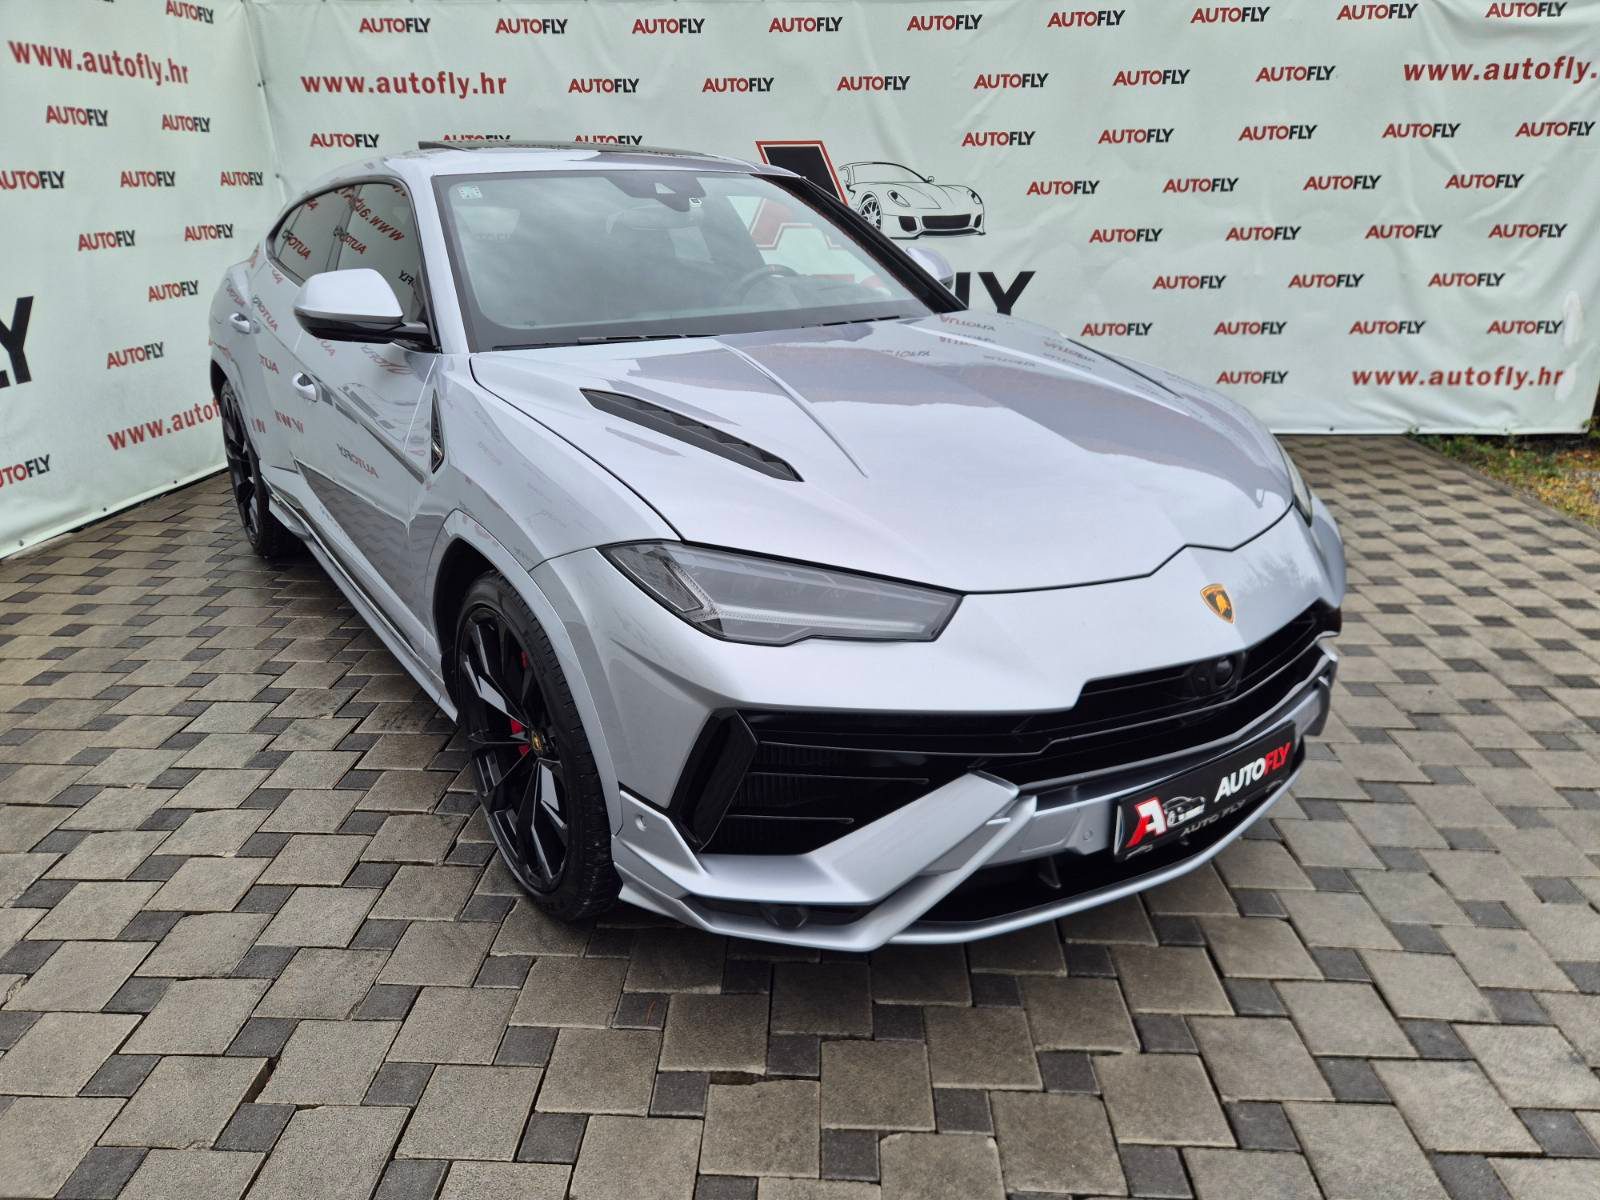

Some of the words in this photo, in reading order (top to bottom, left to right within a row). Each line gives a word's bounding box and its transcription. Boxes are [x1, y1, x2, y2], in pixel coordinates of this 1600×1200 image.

[166, 0, 213, 24] AUTOFLY
[1191, 6, 1270, 24] AUTOFLY
[1337, 2, 1418, 20] AUTOFLY
[1485, 2, 1567, 18] AUTOFLY
[359, 18, 430, 33] AUTOFLY
[496, 19, 568, 34] AUTOFLY
[632, 19, 705, 34] AUTOFLY
[769, 16, 843, 32] AUTOFLY
[907, 14, 982, 31] AUTOFLY
[1048, 10, 1125, 27] AUTOFLY
[8, 40, 189, 86] www.autofly.hr
[974, 73, 1049, 89] AUTOFLY
[1113, 69, 1190, 86] AUTOFLY
[1256, 65, 1336, 82] AUTOFLY
[300, 71, 507, 99] www.autofly.hr
[568, 78, 640, 93] AUTOFLY
[702, 77, 774, 93] AUTOFLY
[837, 76, 910, 91] AUTOFLY
[46, 105, 108, 127] AUTOFLY
[162, 115, 210, 132] AUTOFLY
[1098, 128, 1174, 144] AUTOFLY
[1239, 125, 1317, 141] AUTOFLY
[1382, 123, 1461, 138] AUTOFLY
[1515, 121, 1595, 137] AUTOFLY
[310, 133, 379, 148] AUTOFLY
[961, 131, 1035, 147] AUTOFLY
[121, 171, 175, 187] AUTOFLY
[220, 171, 263, 187] AUTOFLY
[1163, 178, 1239, 193] AUTOFLY
[1303, 175, 1381, 192] AUTOFLY
[1445, 174, 1524, 189] AUTOFLY
[1027, 180, 1100, 196] AUTOFLY
[184, 224, 233, 241] AUTOFLY
[1088, 228, 1163, 243] AUTOFLY
[1226, 226, 1301, 241] AUTOFLY
[1365, 224, 1442, 239] AUTOFLY
[1488, 224, 1567, 239] AUTOFLY
[78, 230, 135, 251] AUTOFLY
[1153, 275, 1226, 289] AUTOFLY
[1288, 274, 1364, 288] AUTOFLY
[1428, 273, 1505, 287] AUTOFLY
[148, 280, 198, 302] AUTOFLY
[1081, 322, 1153, 336] AUTOFLY
[1214, 321, 1287, 335] AUTOFLY
[1350, 321, 1426, 335] AUTOFLY
[1487, 320, 1563, 334] AUTOFLY
[107, 341, 163, 369] AUTOFLY
[1217, 371, 1288, 385] AUTOFLY
[1352, 366, 1564, 390] www.autofly.hr
[1214, 742, 1291, 803] AUTOFLY
